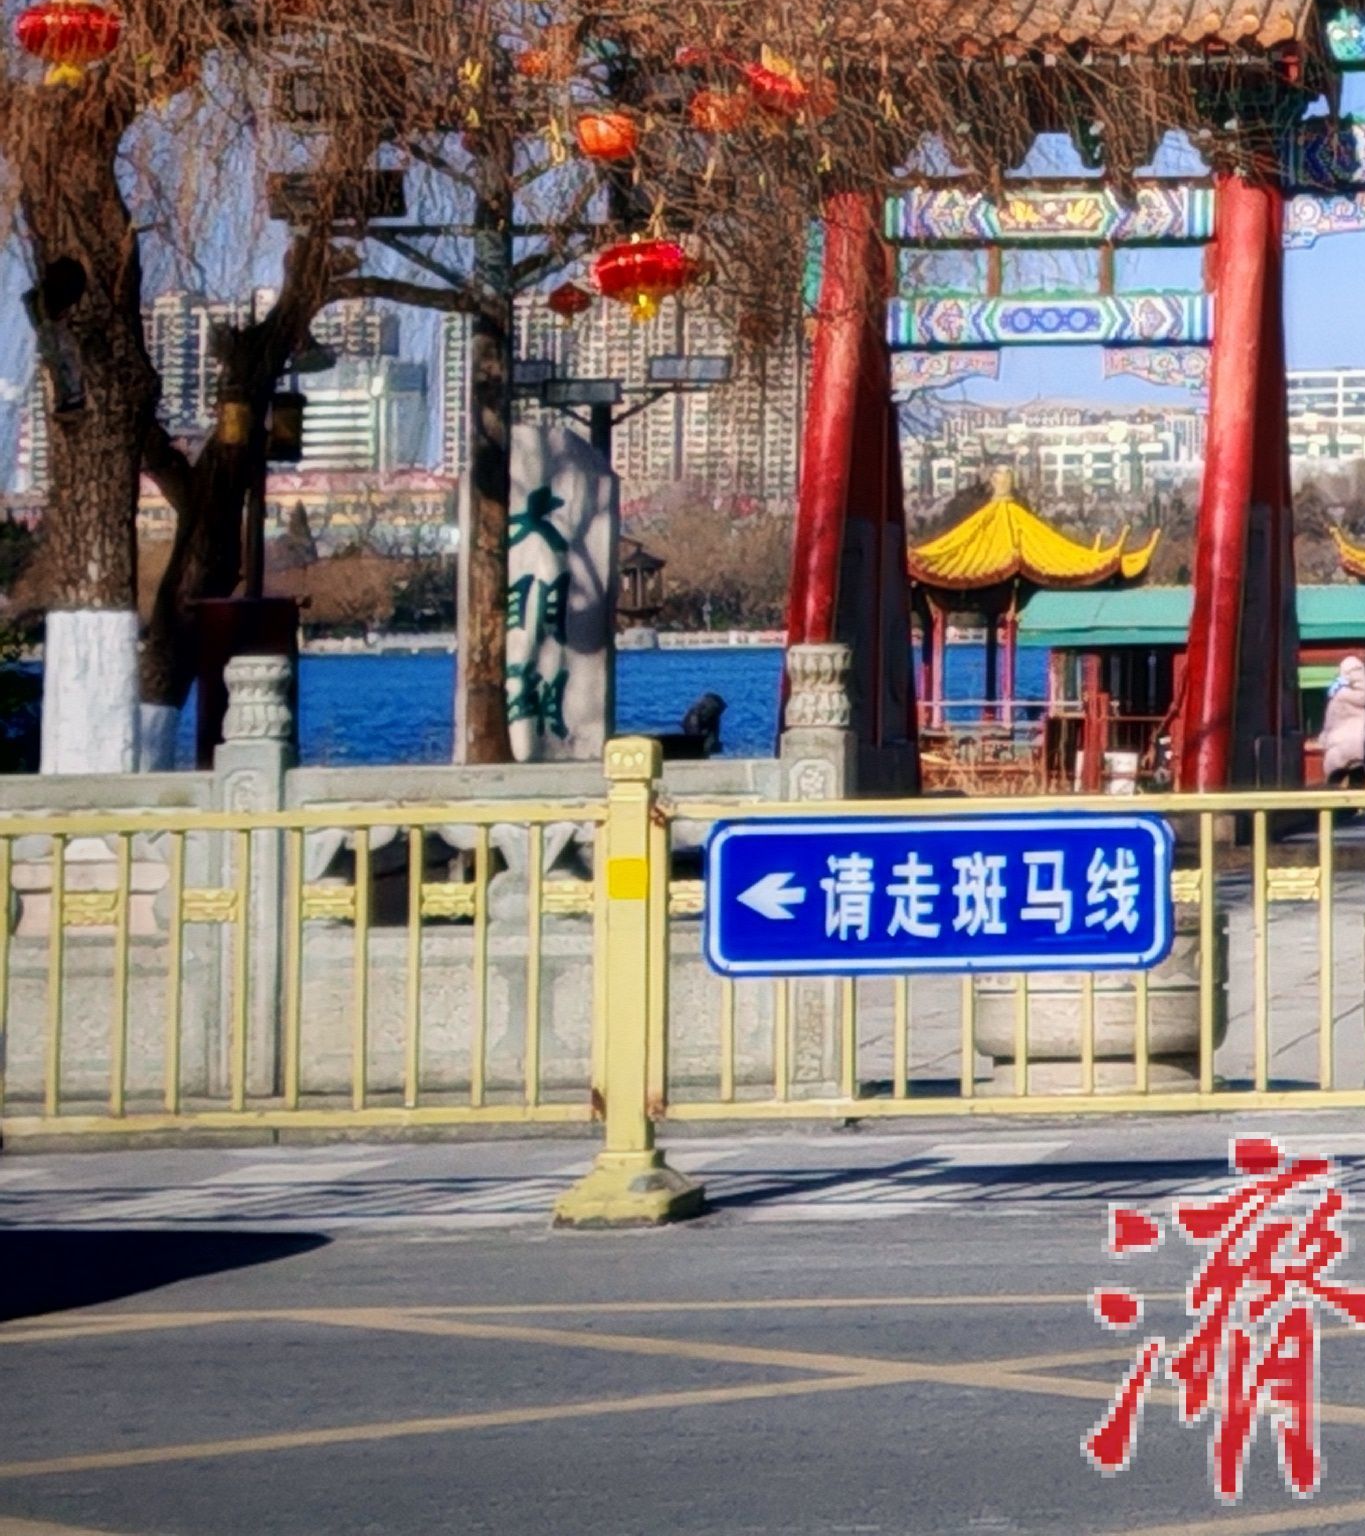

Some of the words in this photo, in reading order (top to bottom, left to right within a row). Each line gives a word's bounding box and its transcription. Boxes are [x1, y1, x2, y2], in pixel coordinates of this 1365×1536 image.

[819, 847, 1140, 941] 请走斑马线
